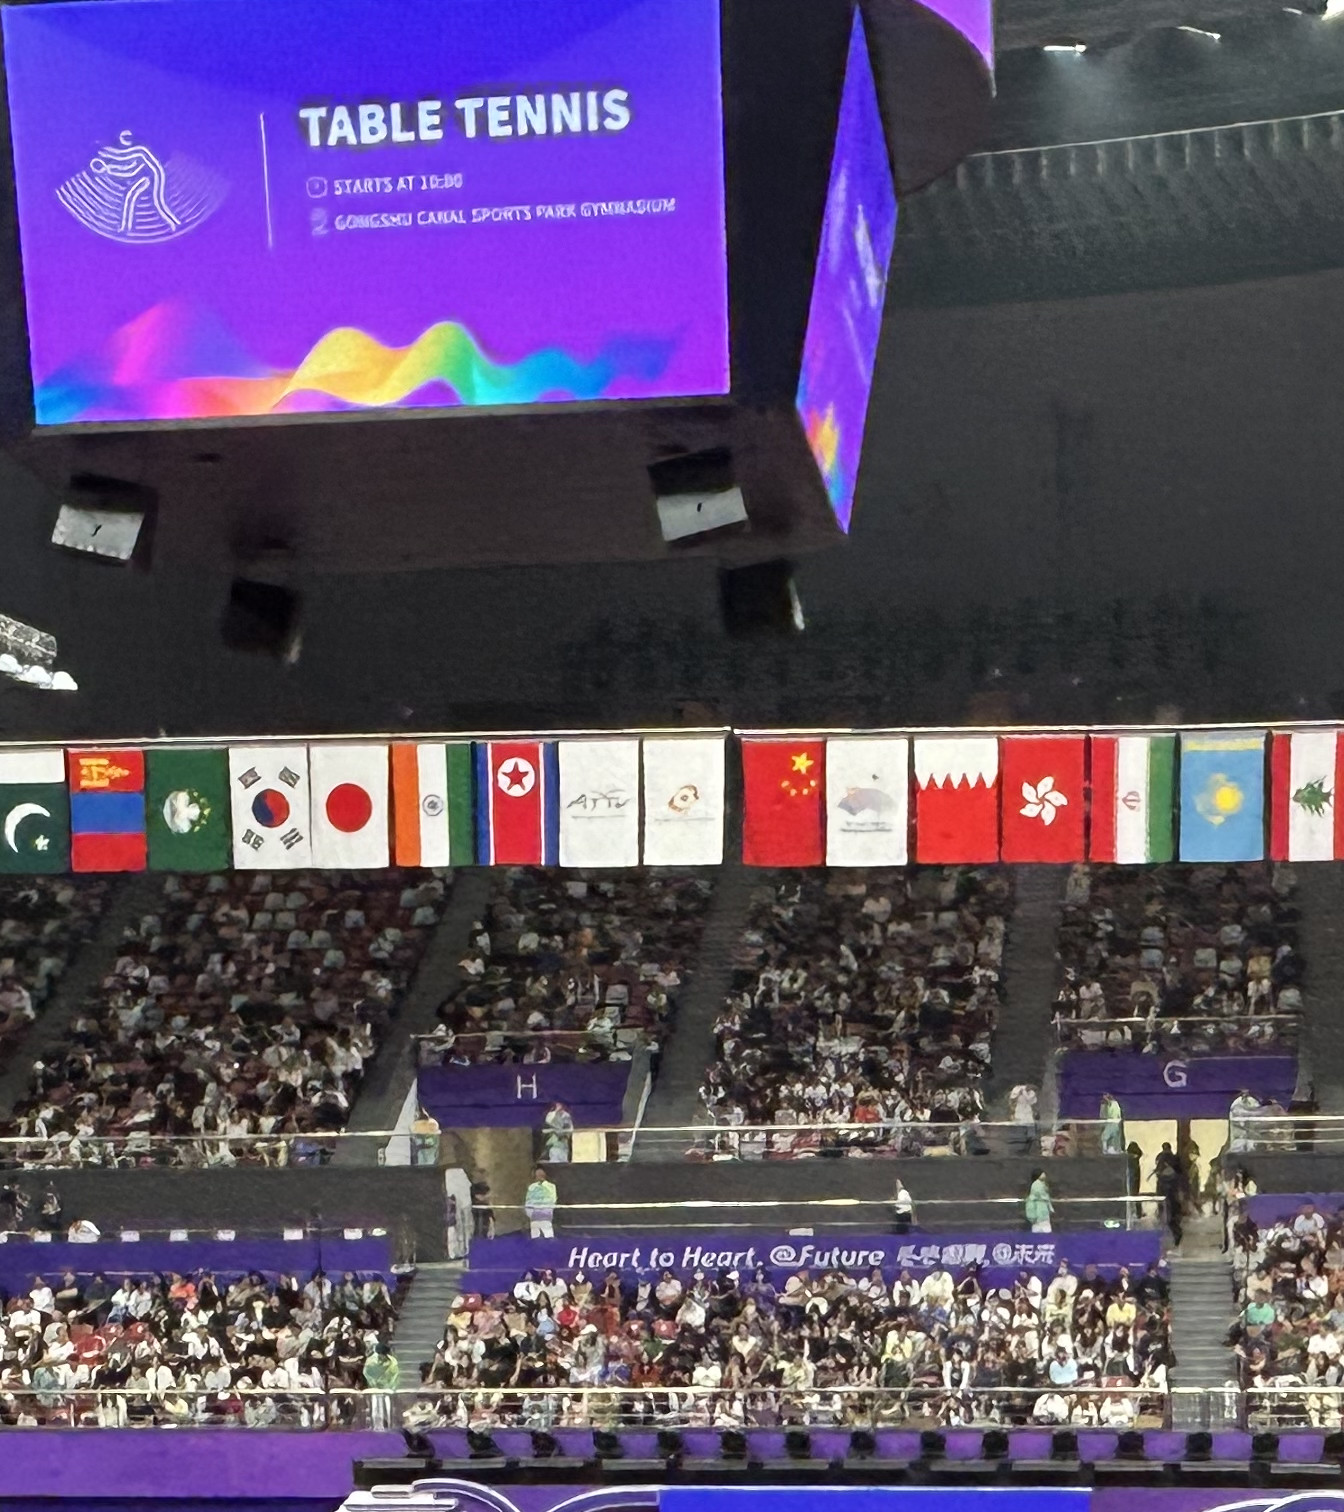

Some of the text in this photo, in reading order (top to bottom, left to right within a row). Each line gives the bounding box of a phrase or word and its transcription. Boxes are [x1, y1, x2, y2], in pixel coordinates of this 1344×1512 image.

[299, 88, 632, 147] TABLE TENNIS
[333, 176, 393, 196] STARTS
[397, 175, 414, 191] AT
[416, 210, 467, 227] CANAL
[471, 205, 532, 224] SPORTS
[535, 203, 577, 219] PARK
[516, 1073, 537, 1099] H
[1163, 1060, 1187, 1088] G
[567, 1246, 641, 1268] Heart
[649, 1247, 675, 1268] to
[769, 1245, 886, 1268] @Future
